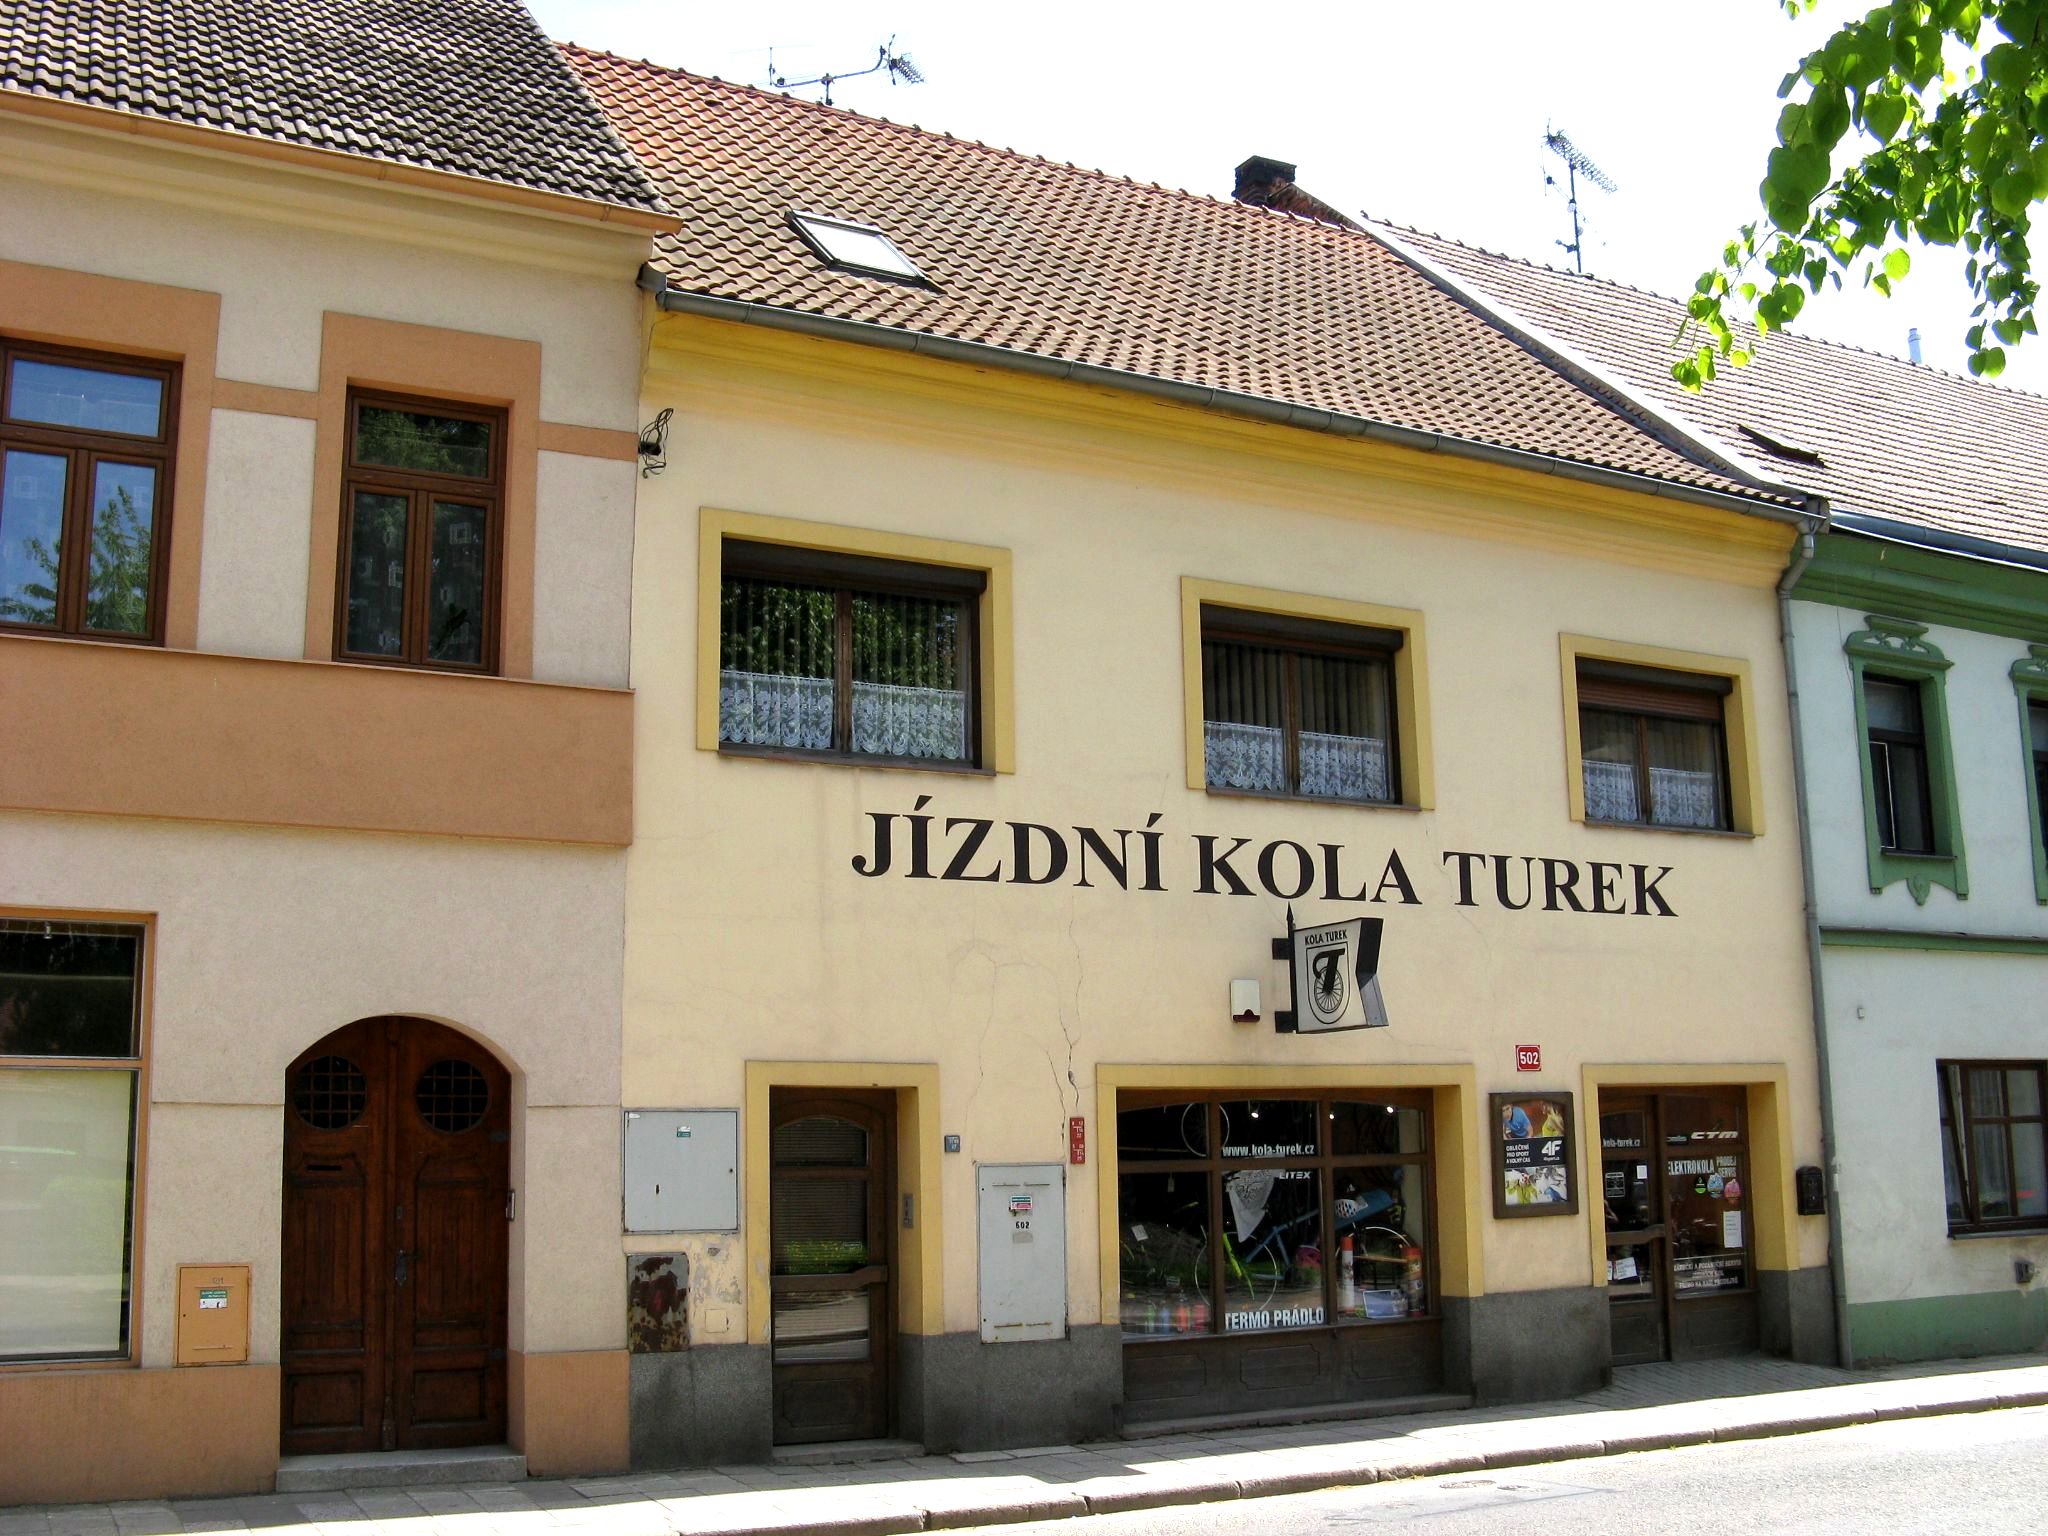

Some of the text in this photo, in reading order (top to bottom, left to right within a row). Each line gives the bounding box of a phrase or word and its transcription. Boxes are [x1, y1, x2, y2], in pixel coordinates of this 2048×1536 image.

[852, 794, 1680, 918] JÍZDNÍ KOLA TUREK
[1304, 928, 1348, 946] KOLA TUREK
[1519, 1051, 1540, 1065] 502
[1690, 1131, 1739, 1140] CTM
[1222, 1142, 1316, 1157] www.kola-turek.cz
[1541, 1140, 1563, 1156] 4F
[1225, 1303, 1325, 1330] TERMO PRÁDLO
